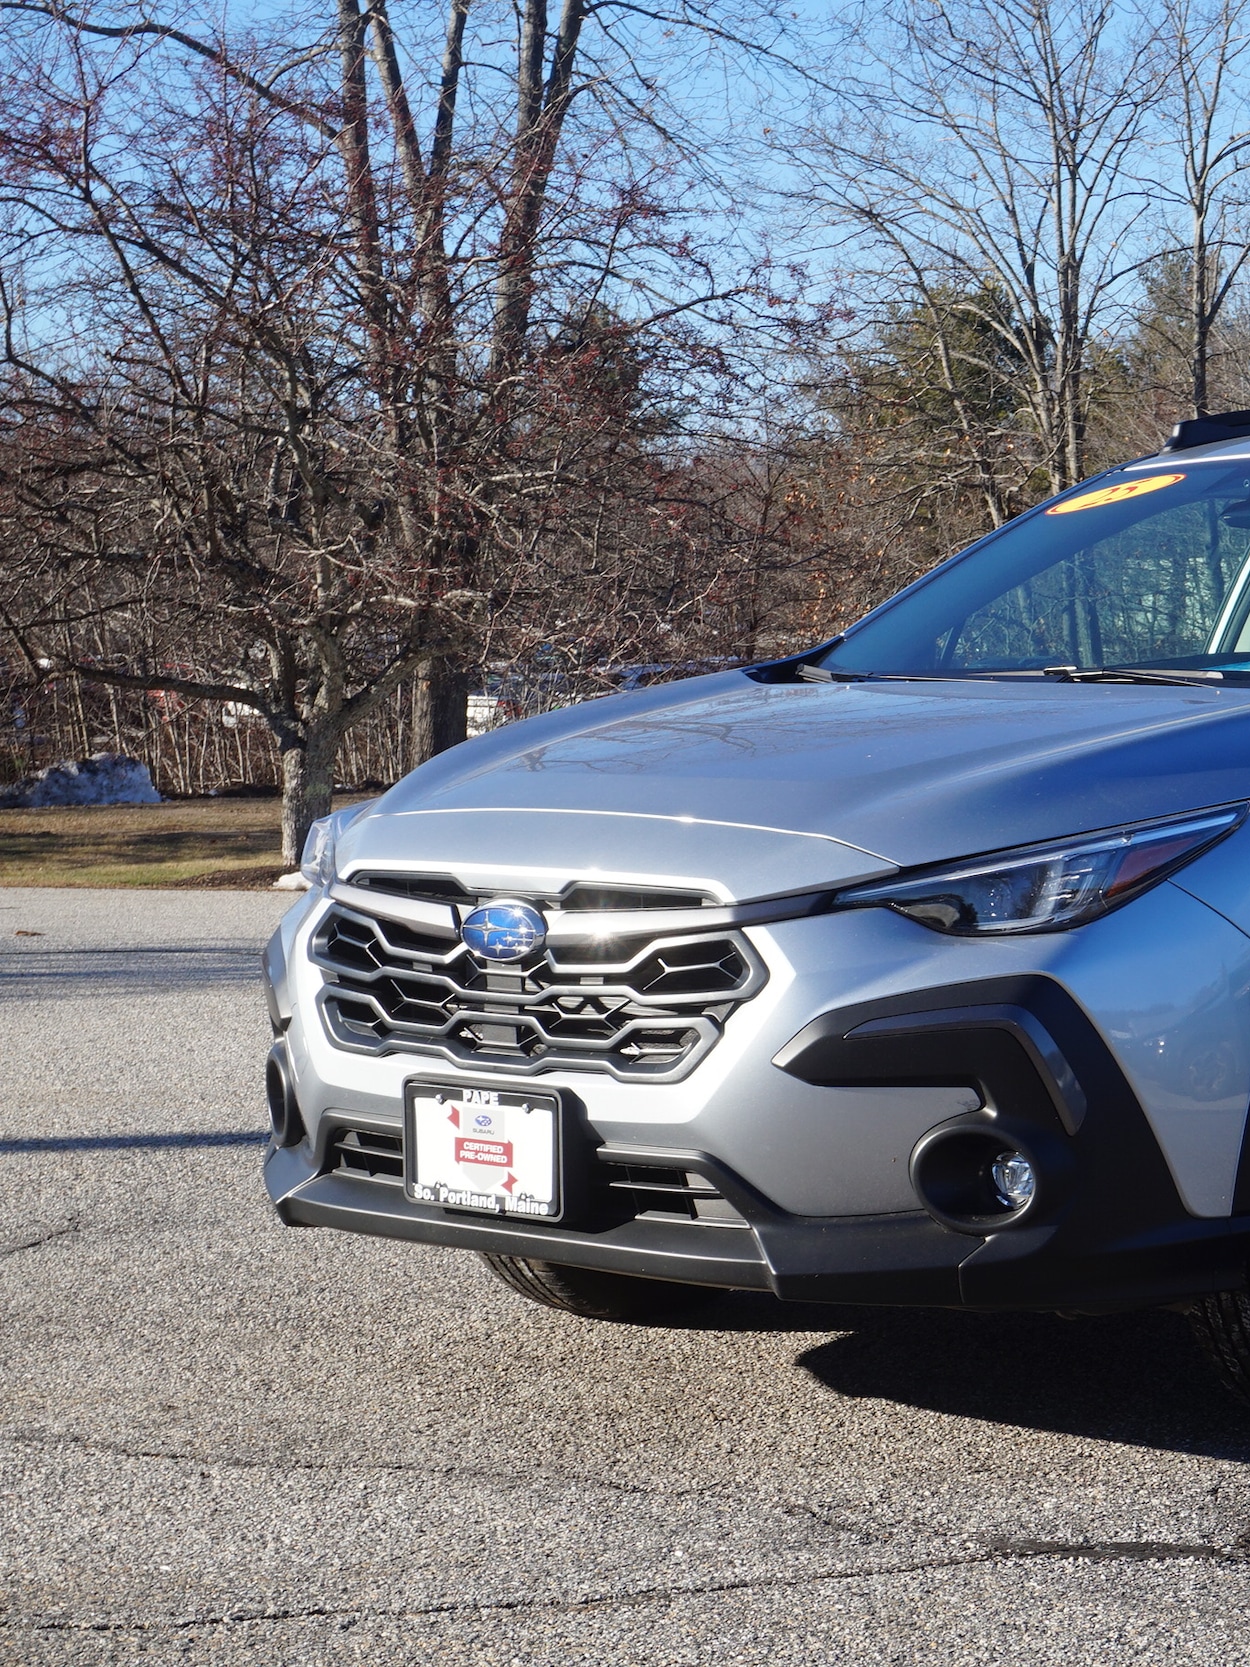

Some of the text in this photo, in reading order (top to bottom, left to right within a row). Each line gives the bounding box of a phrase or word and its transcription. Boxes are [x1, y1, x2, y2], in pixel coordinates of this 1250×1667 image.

[462, 1089, 500, 1106] PAPE
[472, 1127, 495, 1135] SUBARU
[463, 1141, 504, 1154] CERTIFIED
[459, 1150, 508, 1163] PRE-OWNED
[413, 1183, 549, 1216] So. Portland, Maine
